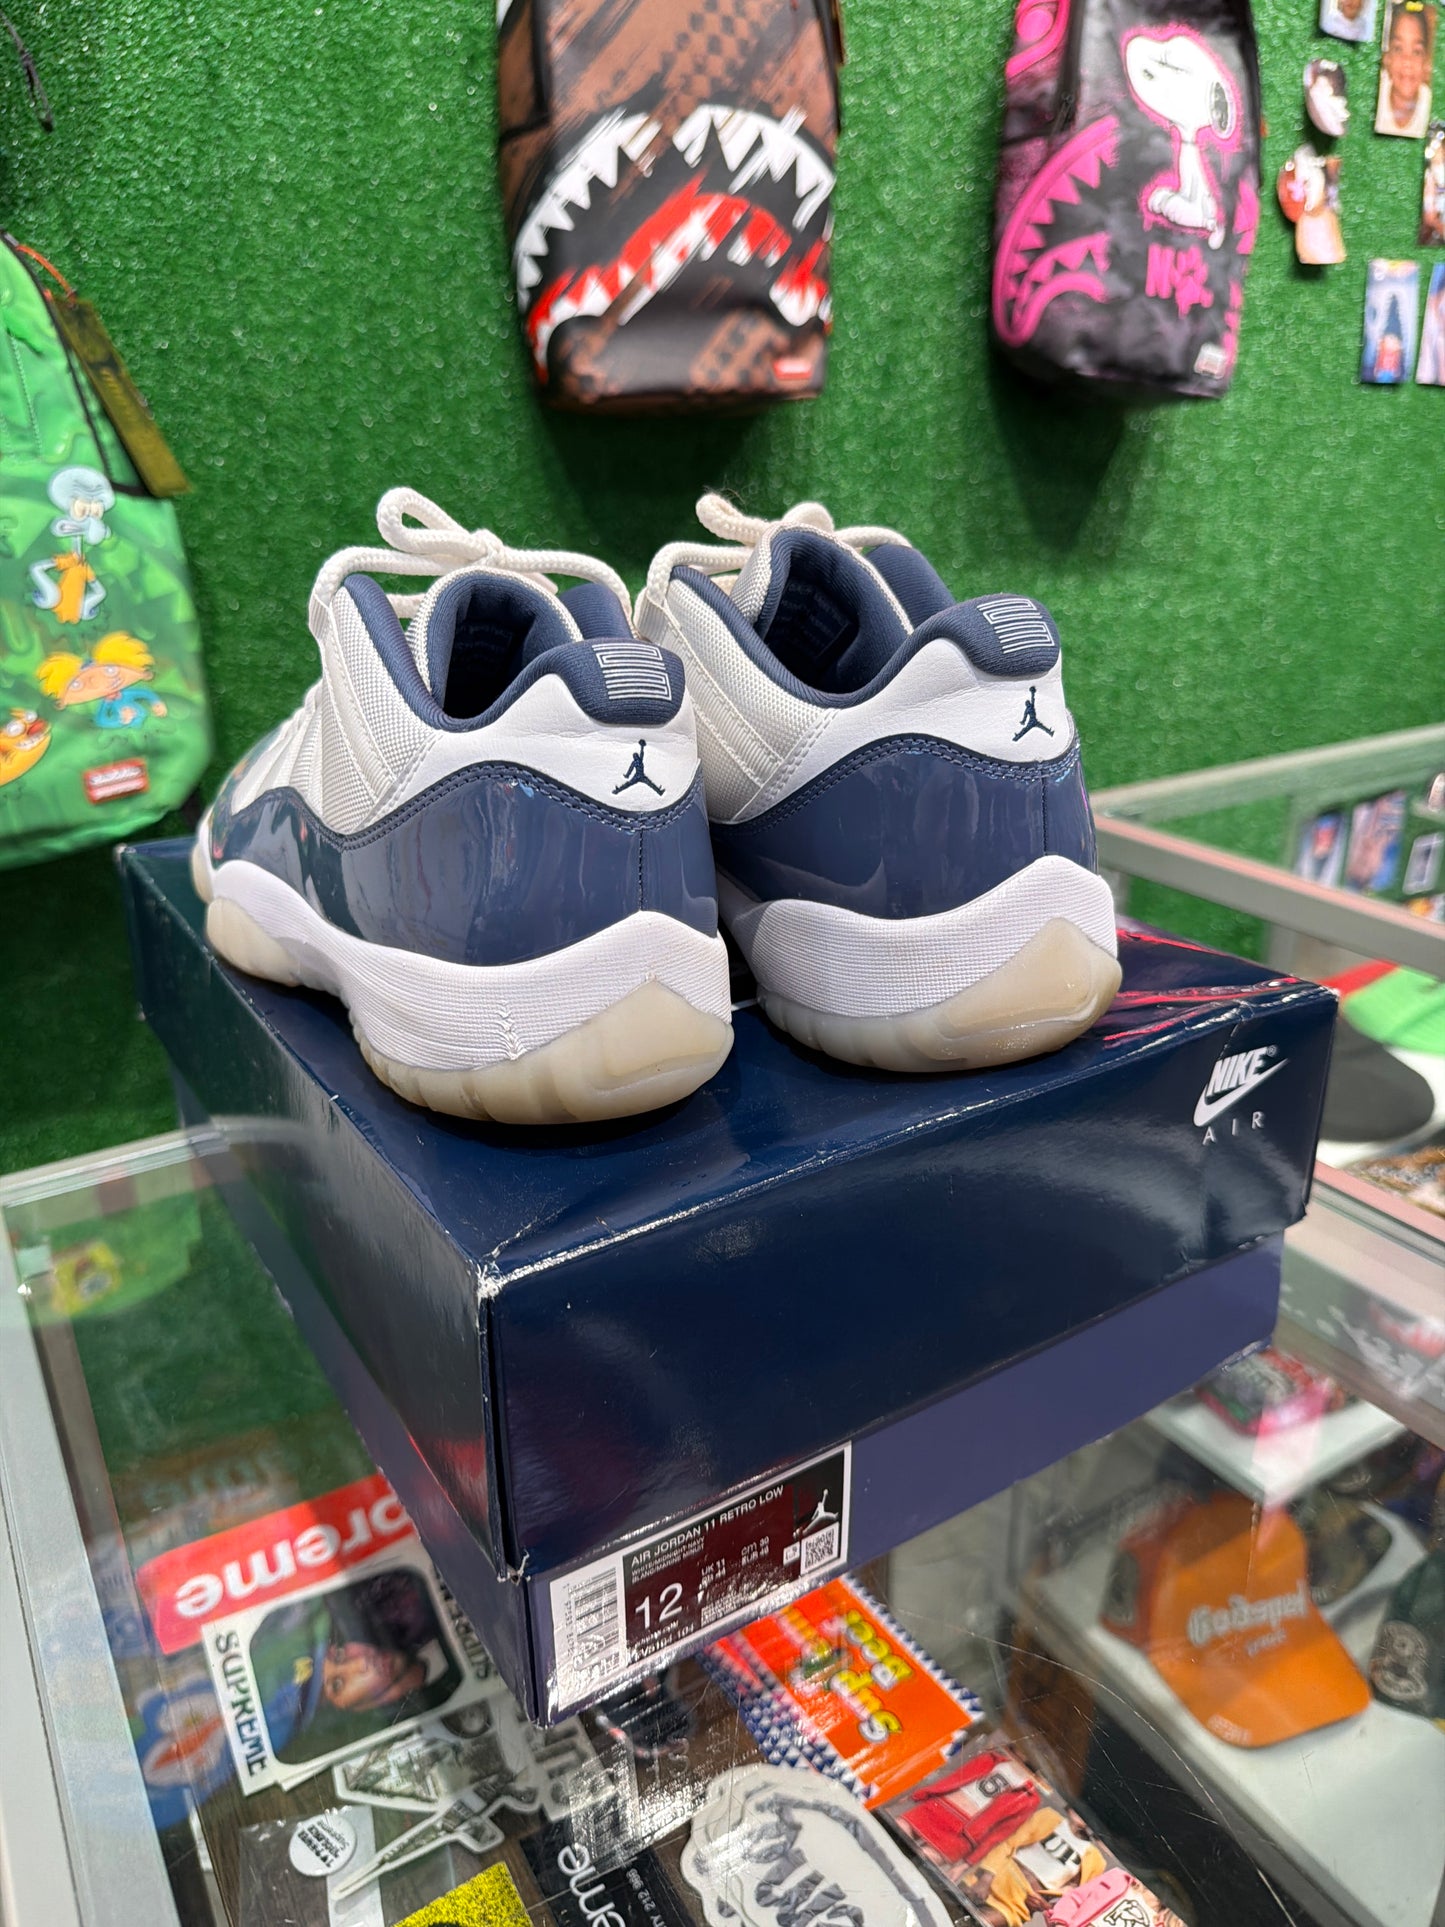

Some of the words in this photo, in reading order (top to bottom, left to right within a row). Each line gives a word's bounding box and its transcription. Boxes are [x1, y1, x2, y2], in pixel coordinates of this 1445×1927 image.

[1207, 1046, 1270, 1093] NIKE
[1201, 1110, 1265, 1146] AIR
[631, 1548, 651, 1567] AIR
[654, 1524, 701, 1556] JORDAN
[704, 1517, 715, 1532] 11
[719, 1498, 755, 1524] RETRO
[759, 1484, 783, 1505] LOW
[635, 1582, 683, 1630] 12
[214, 1629, 269, 1777] SUPREME
[636, 1890, 657, 1912] 212
